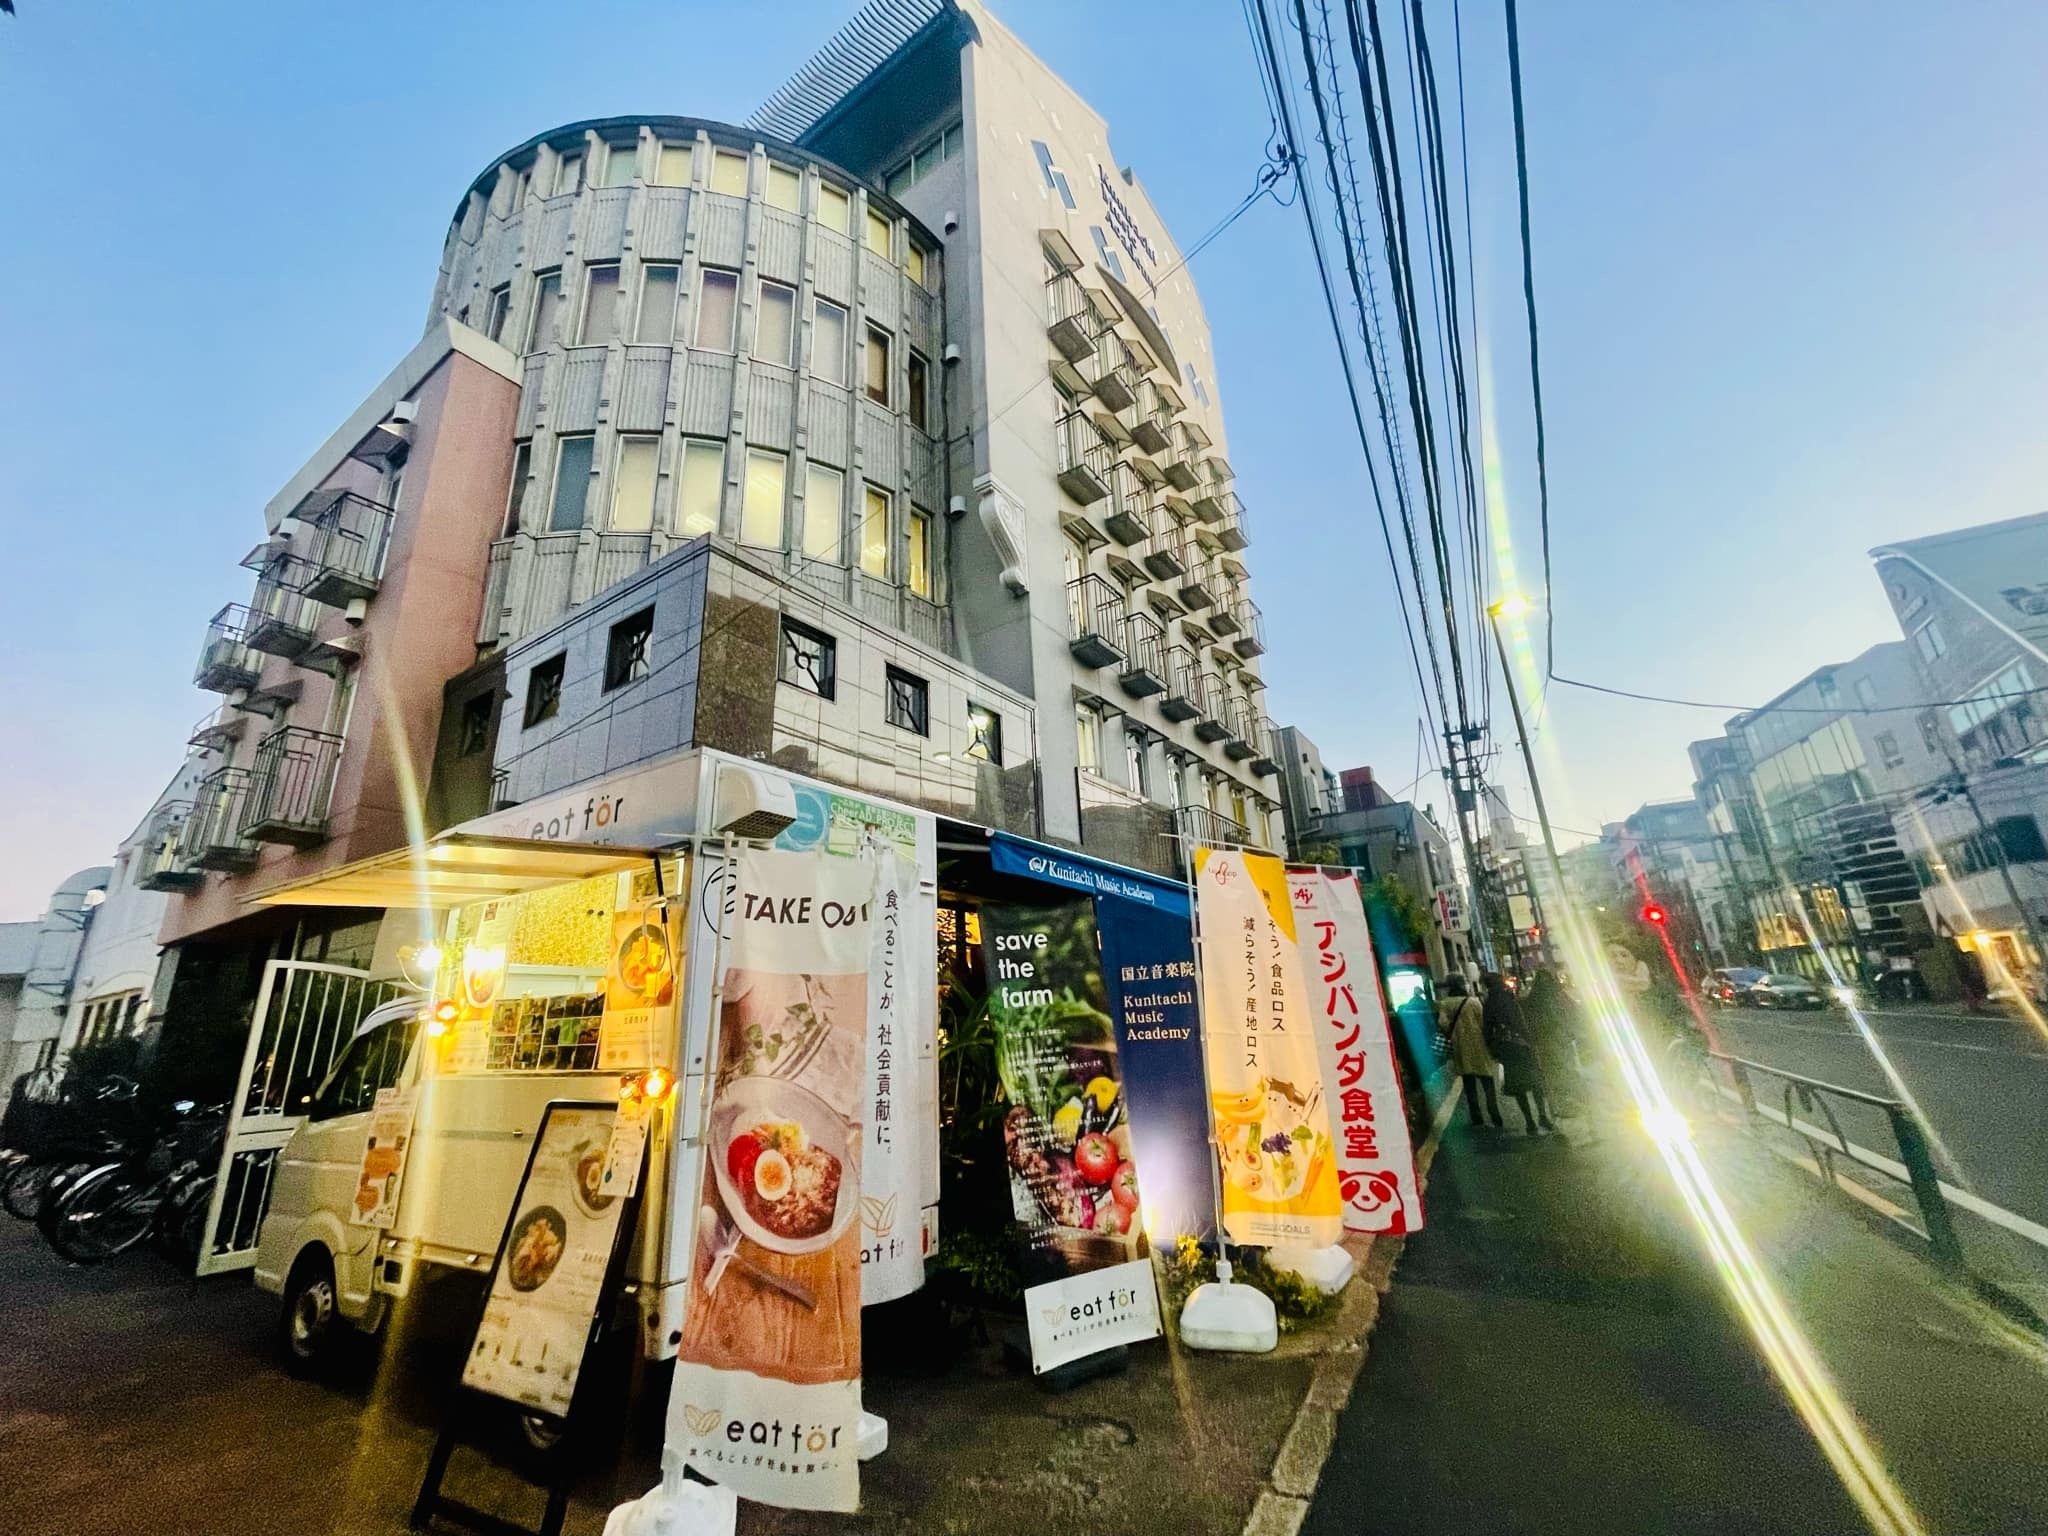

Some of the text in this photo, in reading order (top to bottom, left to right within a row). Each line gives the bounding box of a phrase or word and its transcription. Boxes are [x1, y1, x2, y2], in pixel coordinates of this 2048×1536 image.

[531, 794, 624, 841] eat för
[1048, 862, 1155, 905] Kunitachi Music Academy
[744, 893, 812, 924] TAKE
[995, 933, 1048, 951] save
[998, 958, 1034, 979] the
[1121, 961, 1195, 982] 国立音楽院
[1001, 987, 1054, 1009] farm
[1124, 992, 1192, 1008] Kunitachi
[1125, 1010, 1164, 1025] Music
[1127, 1026, 1191, 1041] Academy
[860, 1243, 883, 1264] at
[1070, 1288, 1136, 1321] eat för
[726, 1419, 841, 1454] eat för
